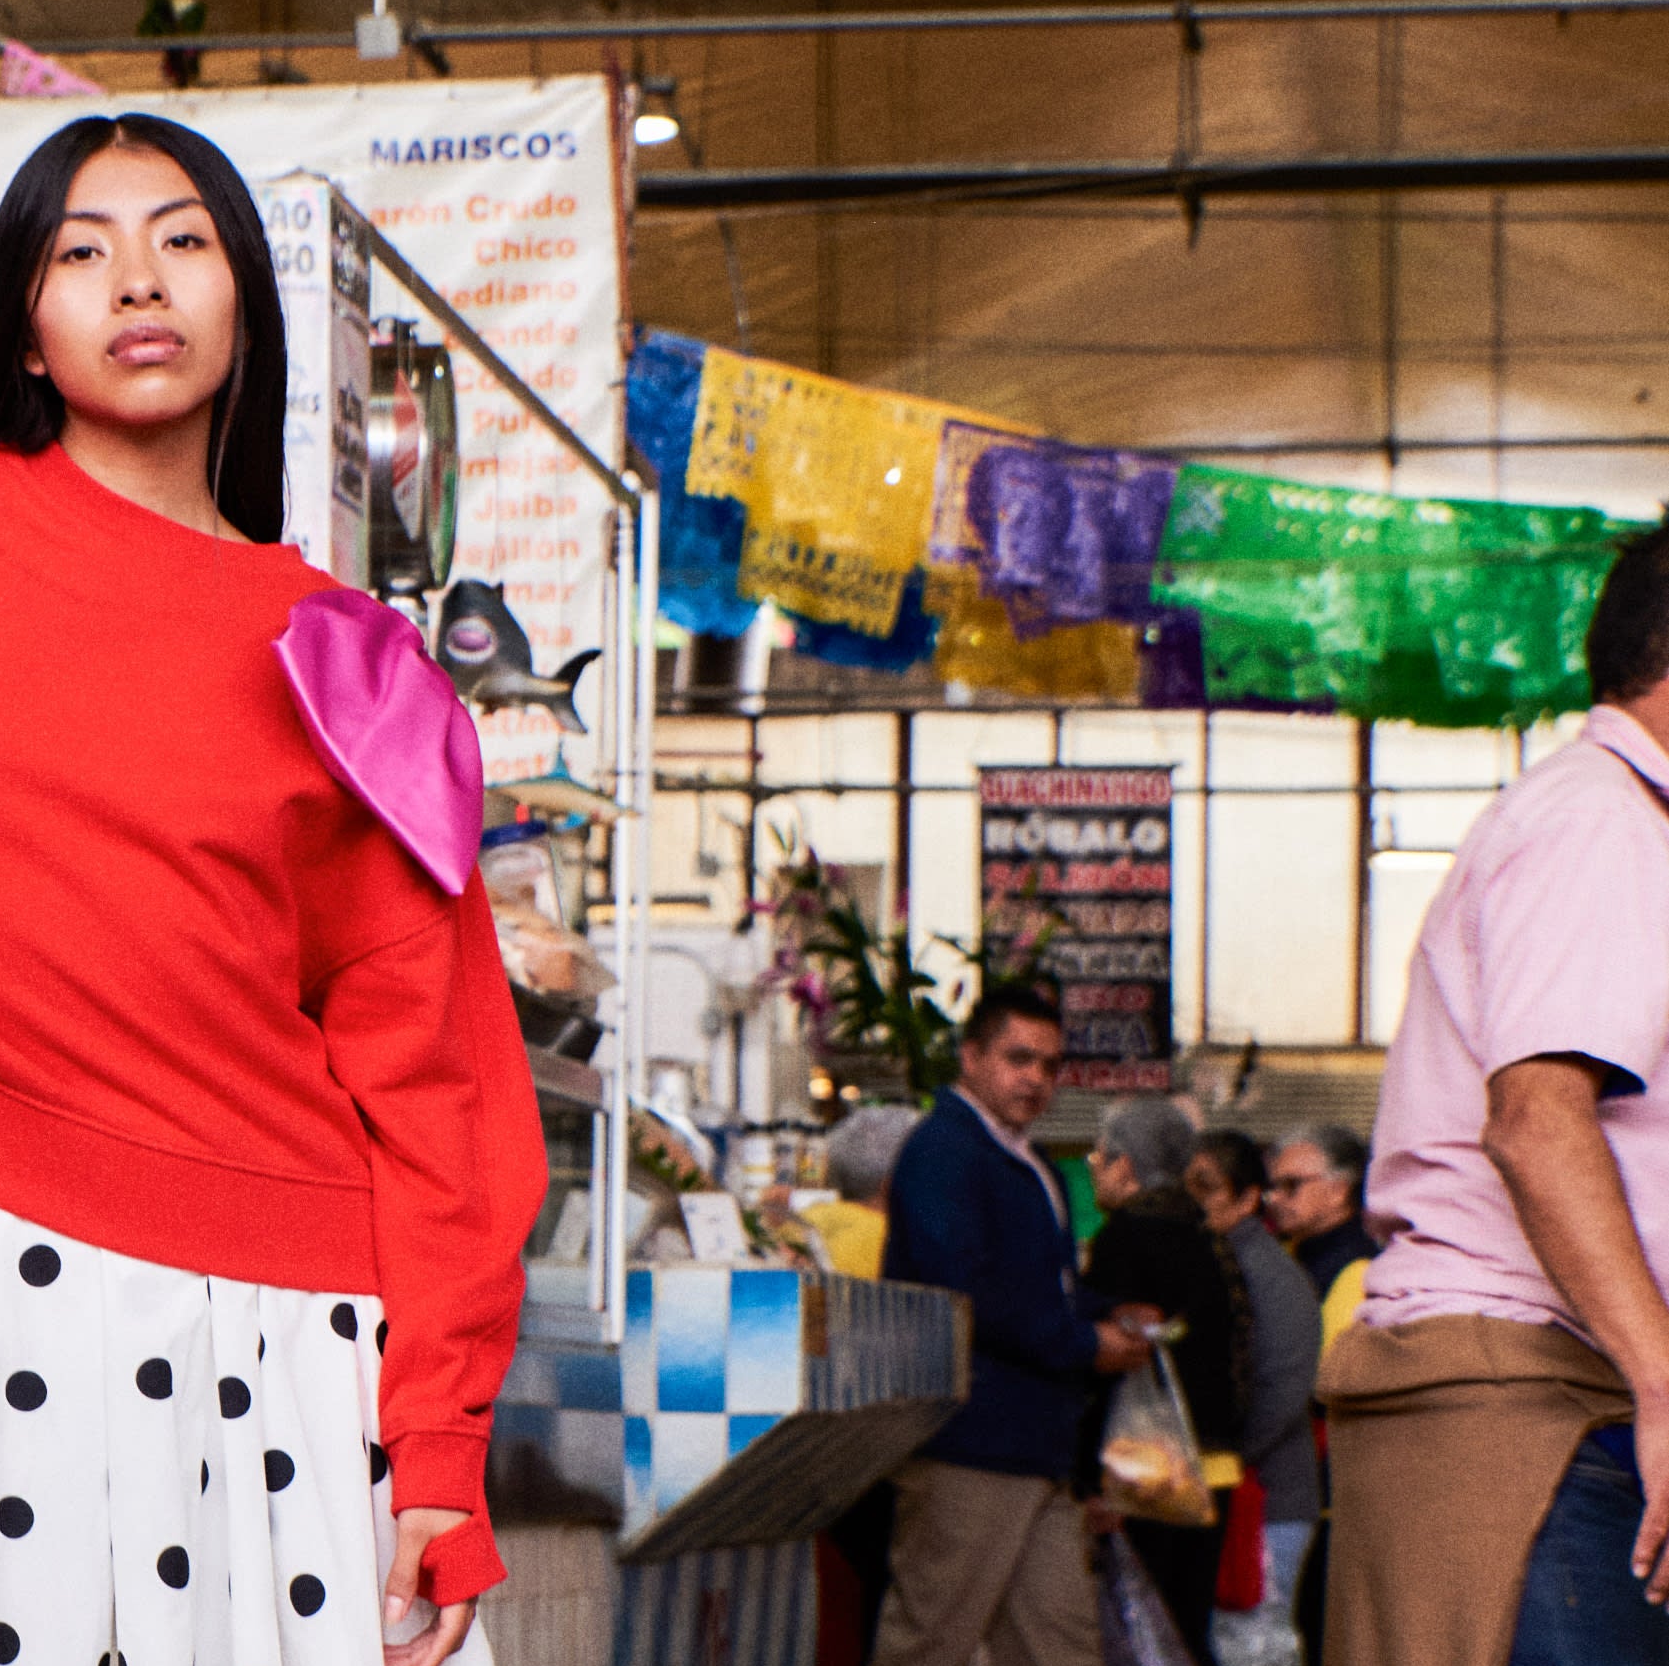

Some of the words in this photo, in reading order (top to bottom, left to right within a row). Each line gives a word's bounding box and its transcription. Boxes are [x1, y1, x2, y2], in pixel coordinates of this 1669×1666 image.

[369, 131, 578, 165] MARISCOS
[465, 193, 578, 223] Crudo
[475, 235, 578, 265] Chico
[475, 494, 578, 521] Jaiba
